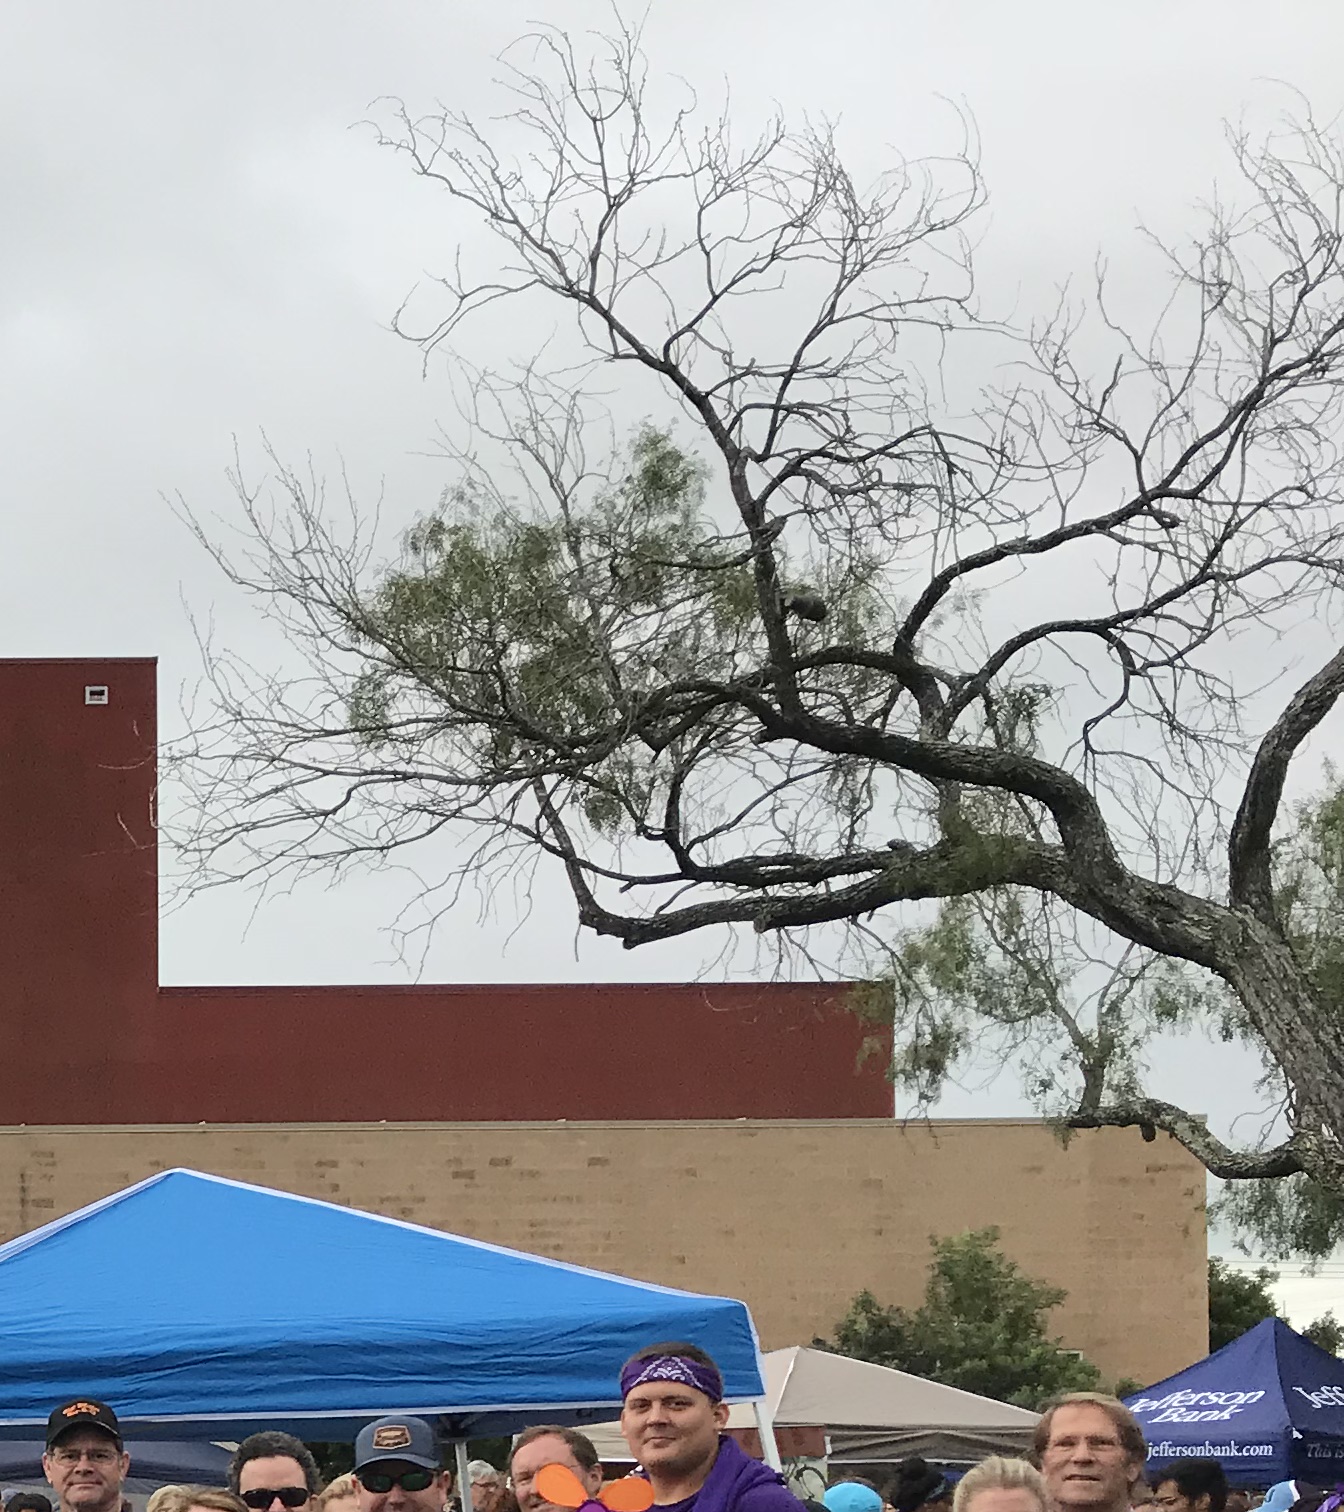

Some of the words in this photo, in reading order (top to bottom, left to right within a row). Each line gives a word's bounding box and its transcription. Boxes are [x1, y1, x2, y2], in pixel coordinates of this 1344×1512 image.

[1128, 1388, 1266, 1413] Jefferson
[1146, 1405, 1245, 1424] Bank
[1146, 1440, 1273, 1461] jeffersonbank.com
